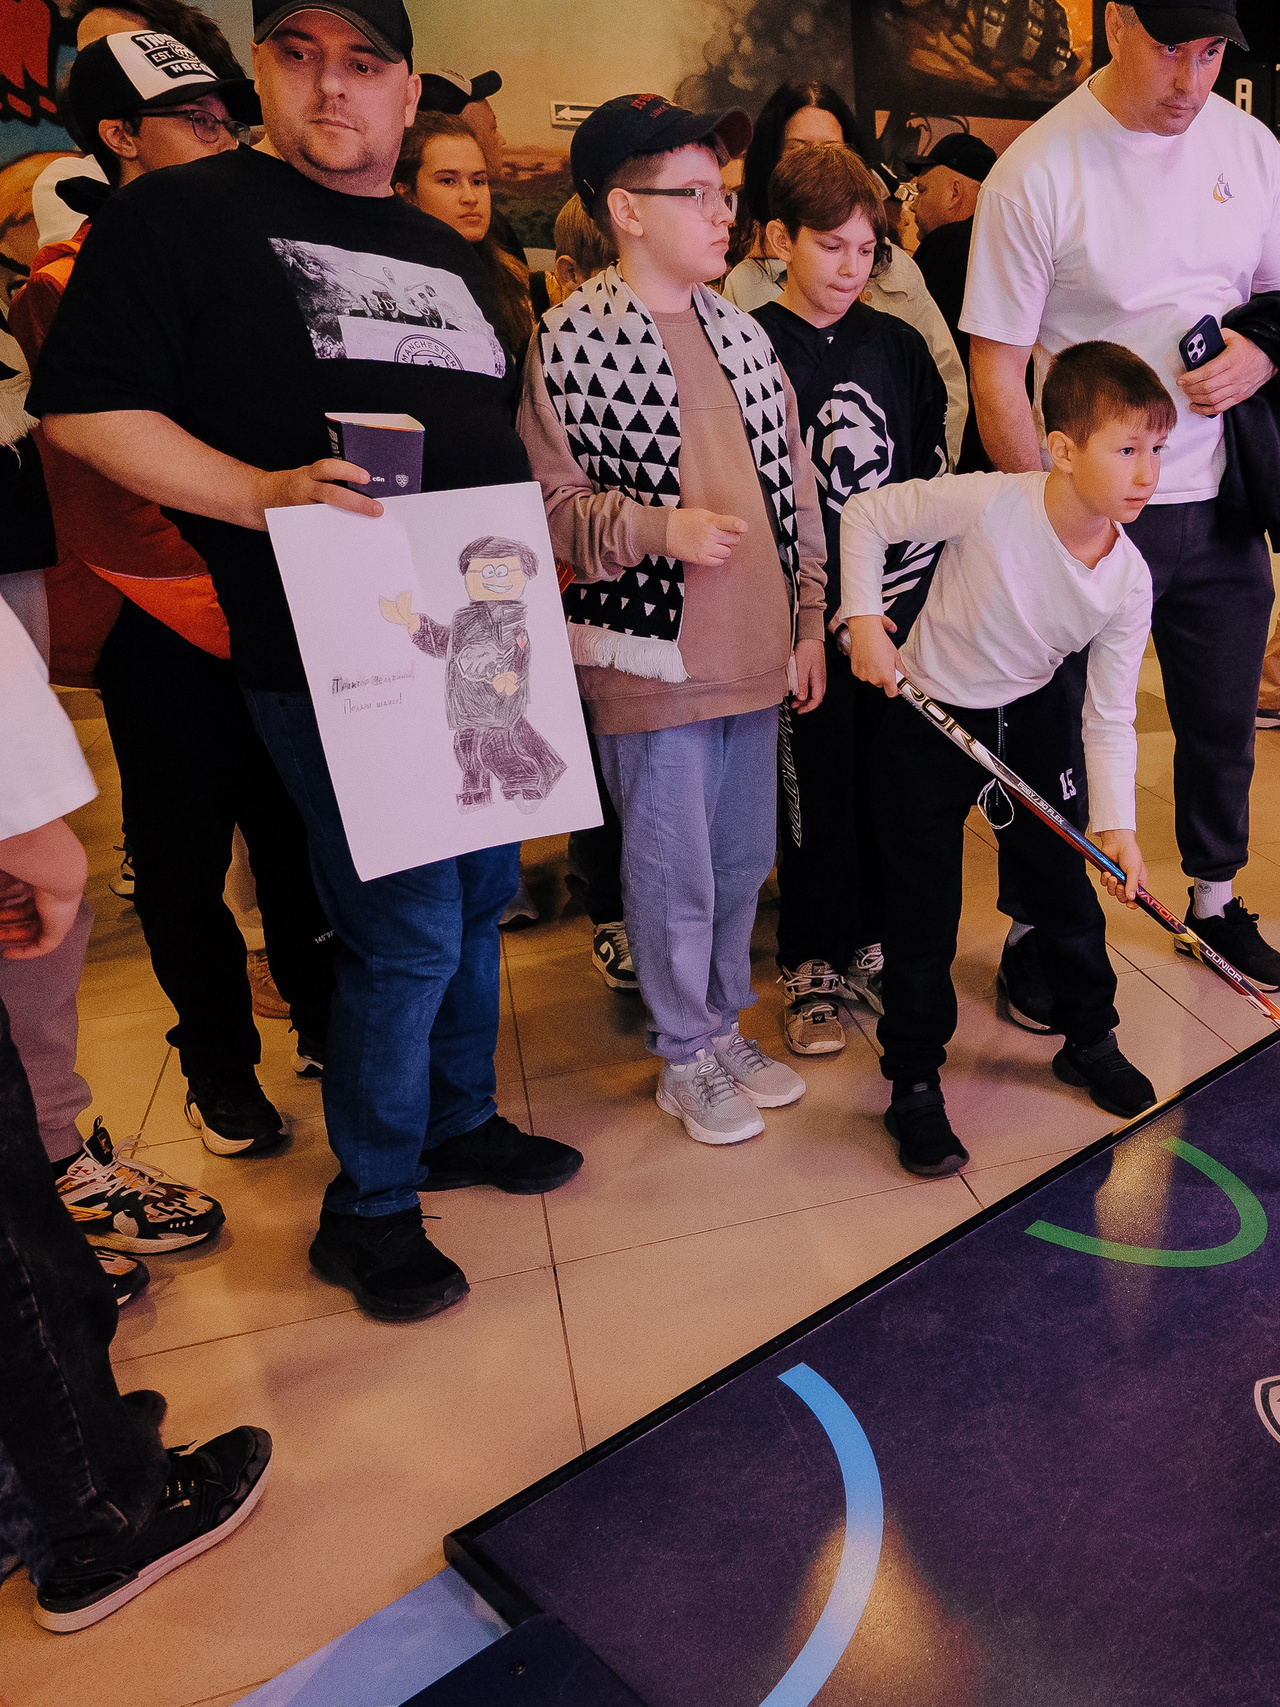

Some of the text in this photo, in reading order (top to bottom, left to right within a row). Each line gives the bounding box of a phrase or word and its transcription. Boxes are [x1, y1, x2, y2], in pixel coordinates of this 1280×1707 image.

[151, 51, 174, 63] EST.
[401, 340, 457, 368] MANCHESTER
[1060, 768, 1077, 800] 15
[1205, 949, 1243, 982] JUNIOR
